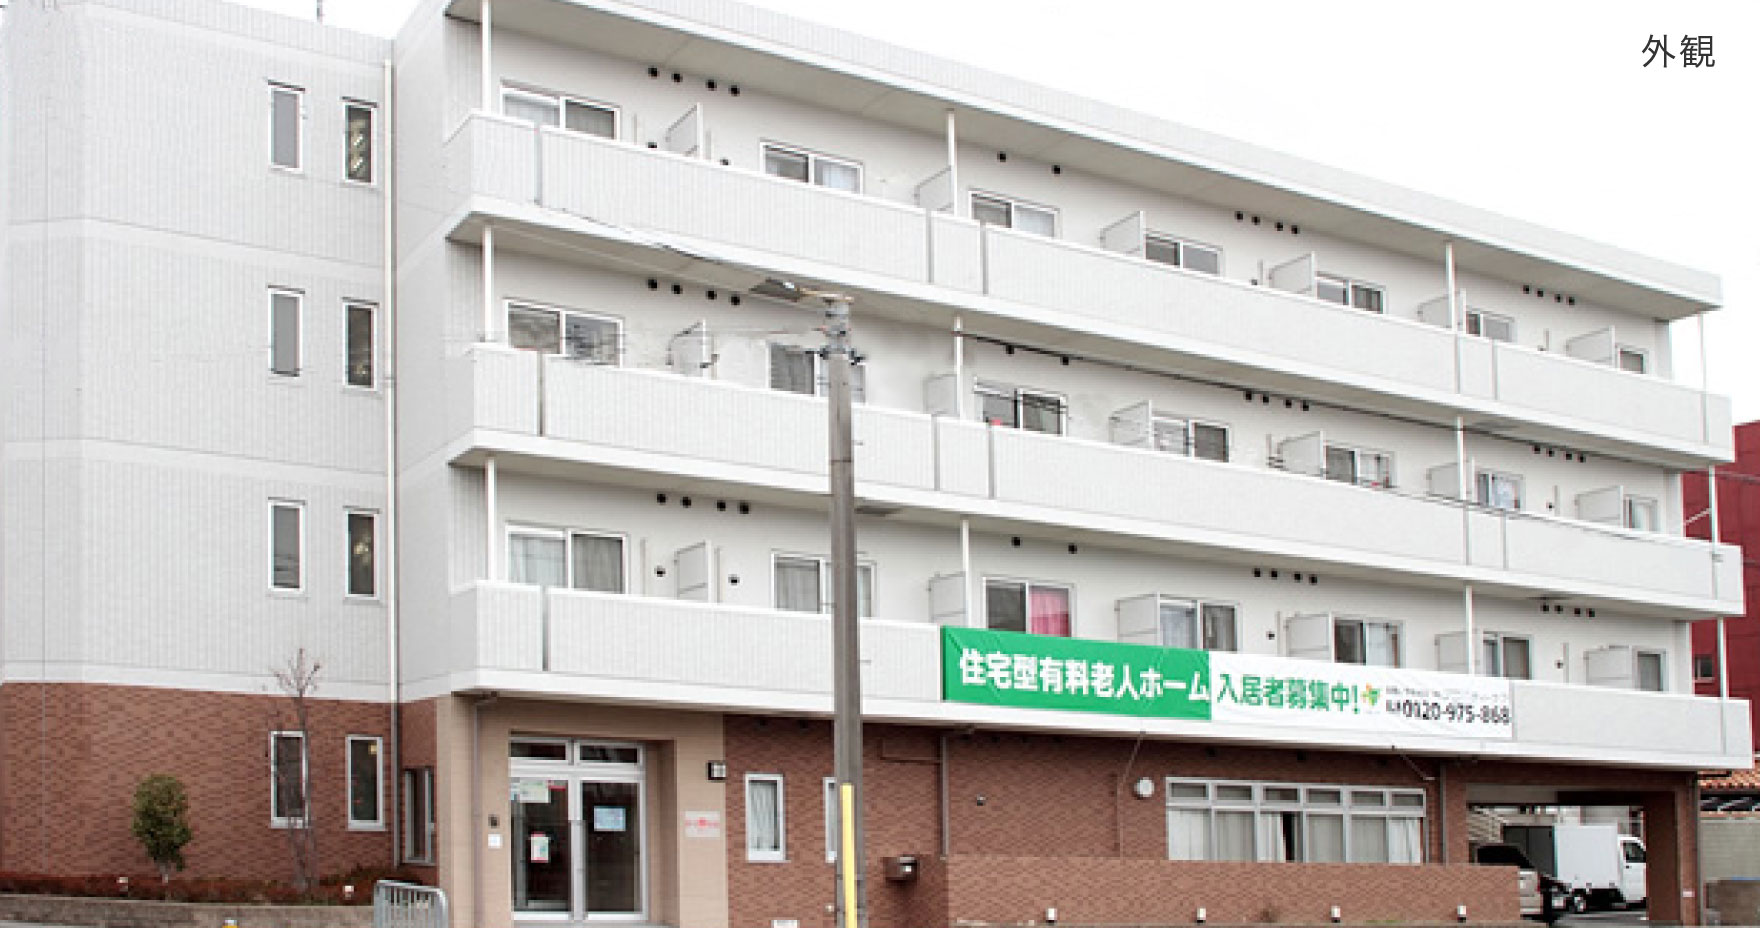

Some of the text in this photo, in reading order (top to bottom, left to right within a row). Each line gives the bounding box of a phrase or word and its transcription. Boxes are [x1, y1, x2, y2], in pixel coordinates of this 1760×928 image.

[959, 648, 1360, 715] 住宅型有料老人ホーム 入居者募集中!
